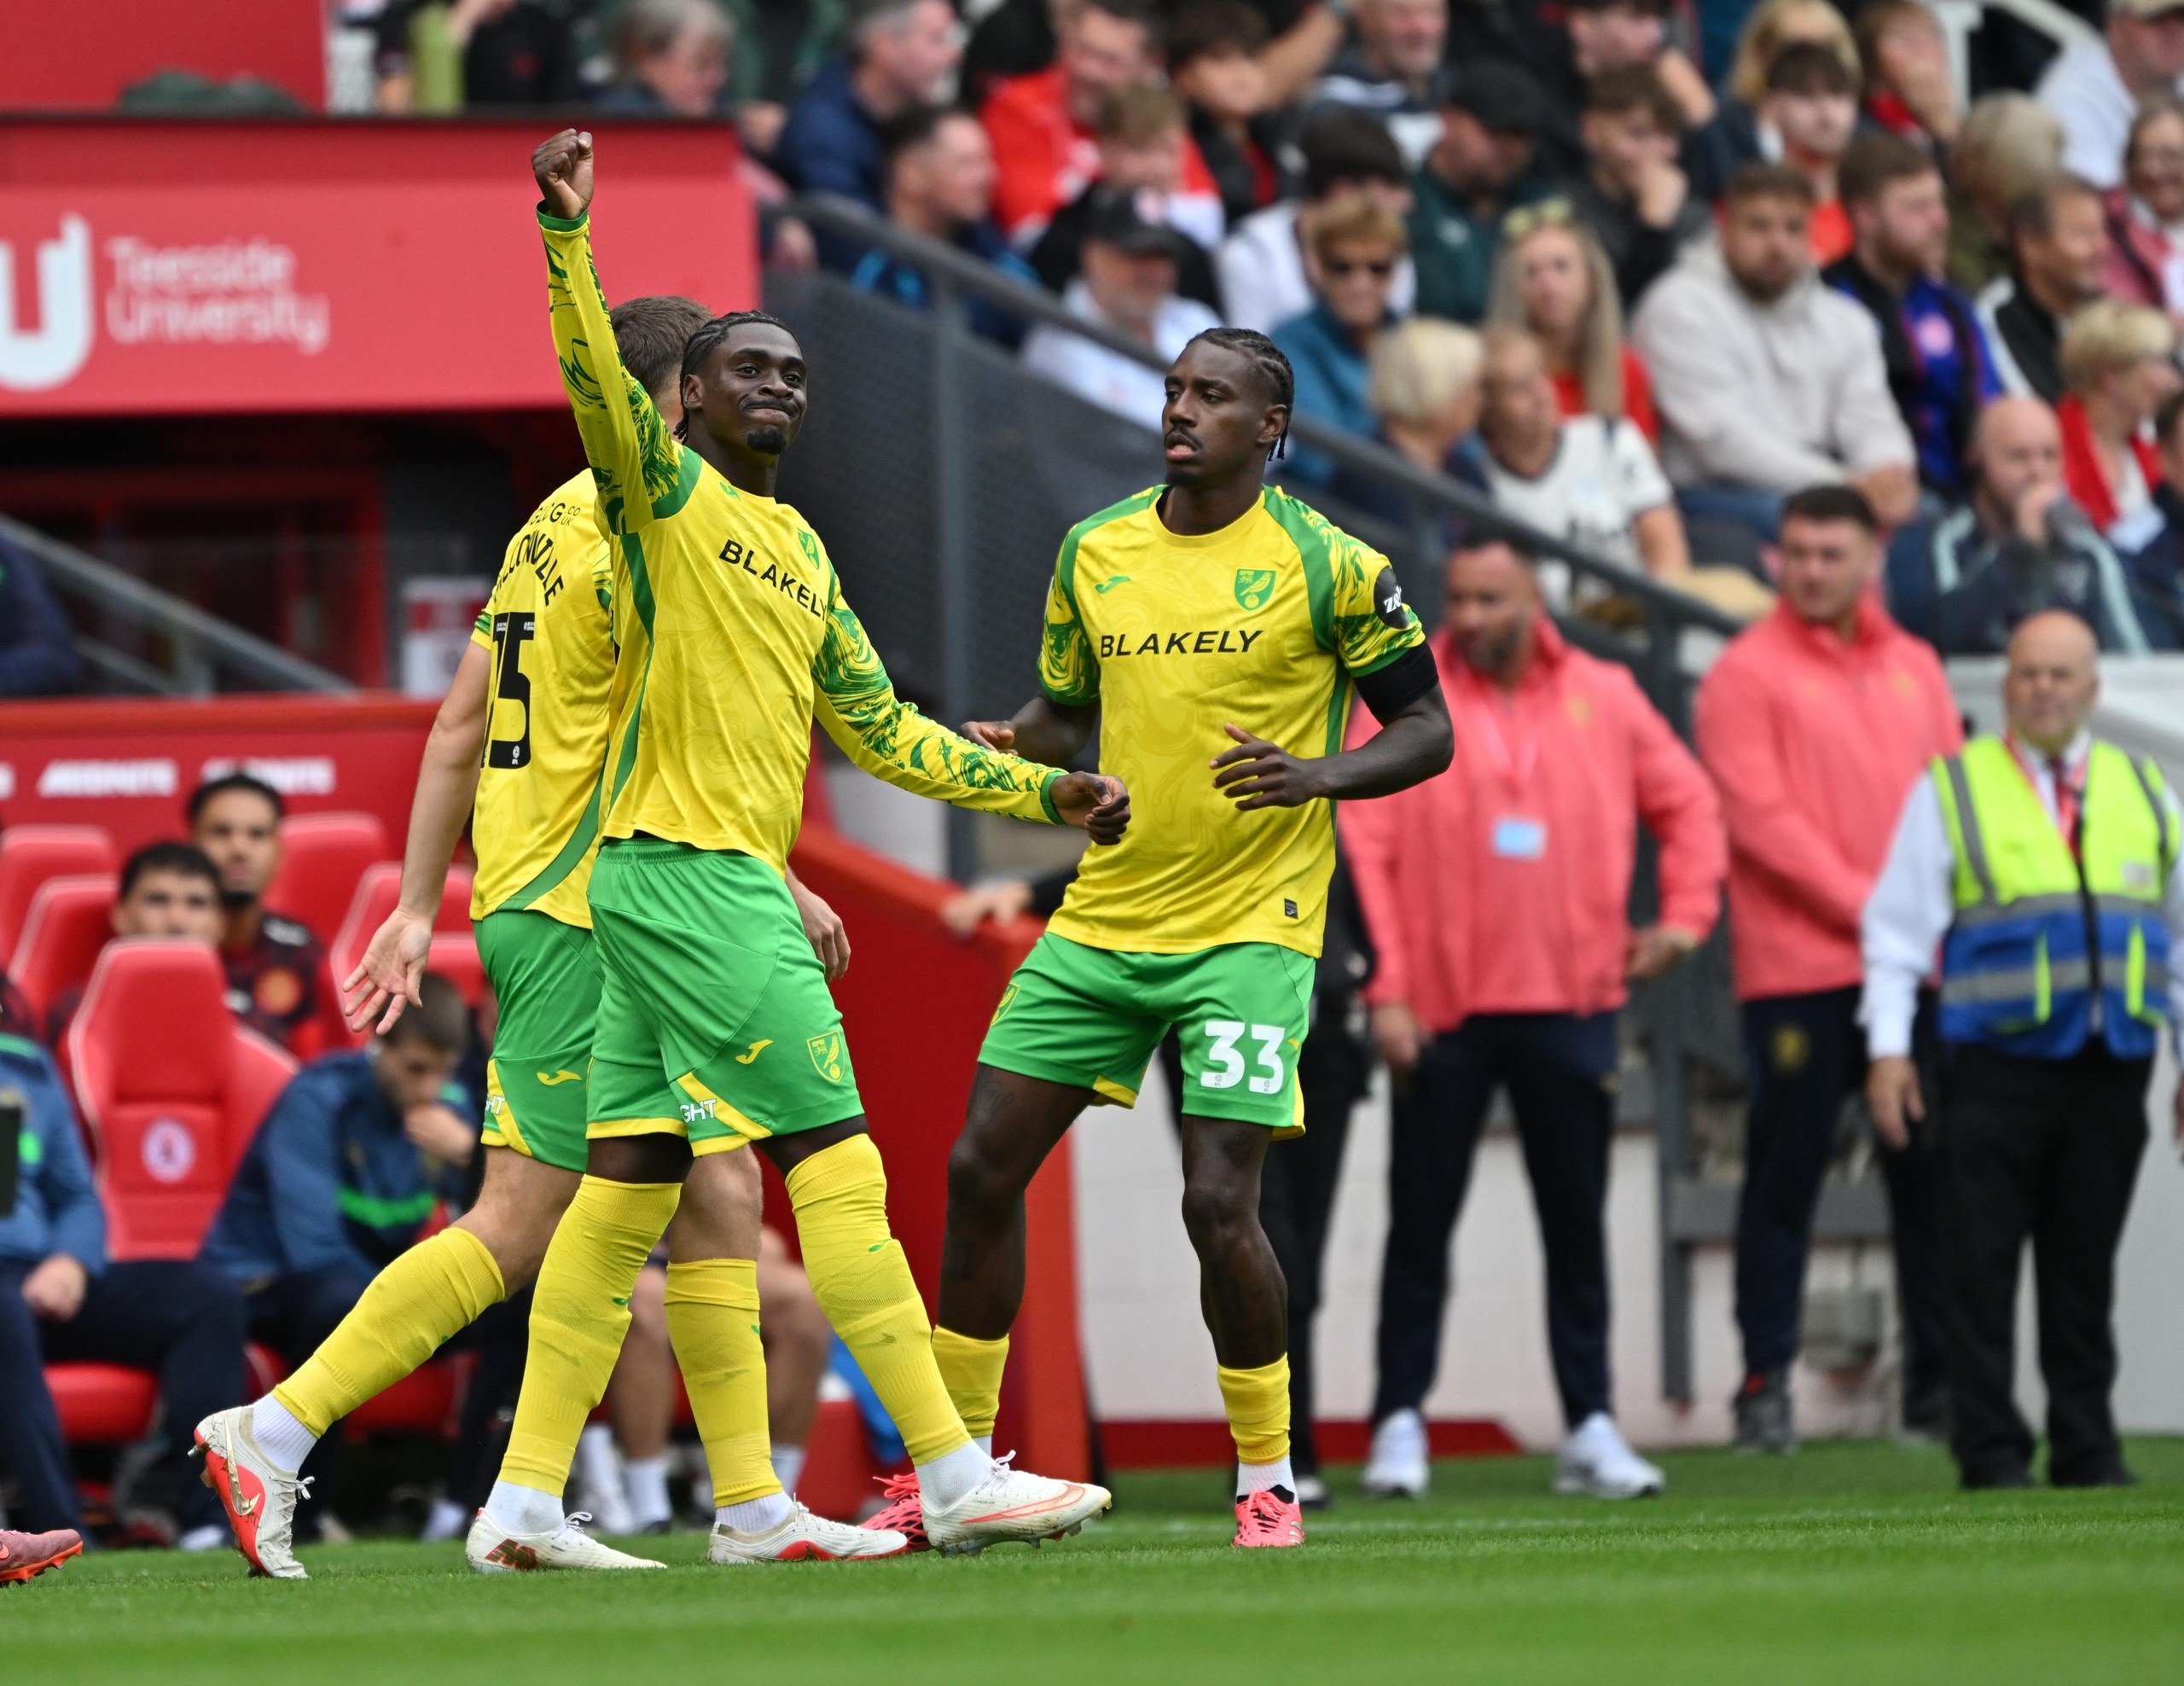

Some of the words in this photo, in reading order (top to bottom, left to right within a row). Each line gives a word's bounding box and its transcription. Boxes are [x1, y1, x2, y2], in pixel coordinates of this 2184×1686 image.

[107, 237, 296, 290] Teesside
[107, 294, 329, 355] University
[718, 538, 827, 621] BLAKELY
[1101, 630, 1264, 658] BLAKELY
[1200, 1020, 1285, 1094] 33
[485, 1092, 506, 1115] HT
